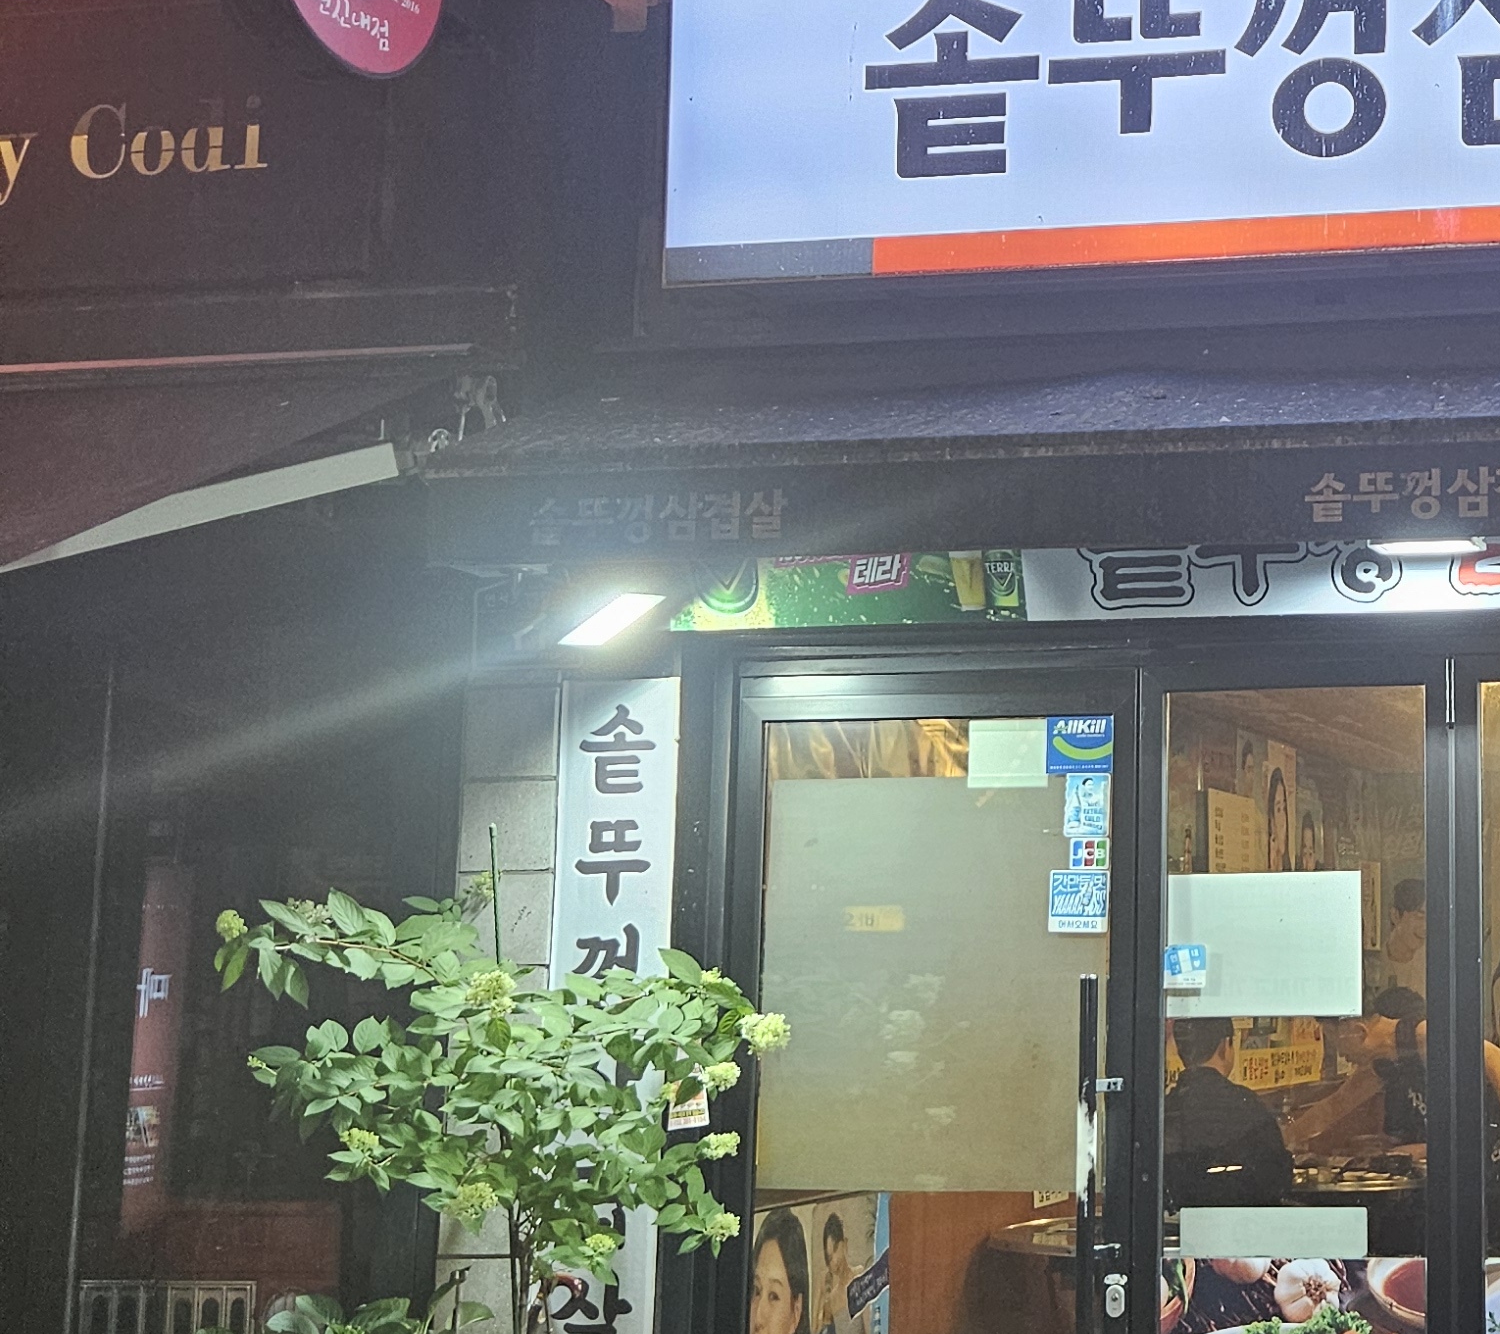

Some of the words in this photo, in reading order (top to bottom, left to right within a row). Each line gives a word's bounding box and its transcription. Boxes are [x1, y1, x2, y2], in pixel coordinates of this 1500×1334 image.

[70, 94, 268, 179] Codi
[852, 554, 904, 586] 테라
[1053, 718, 1107, 735] AllKill
